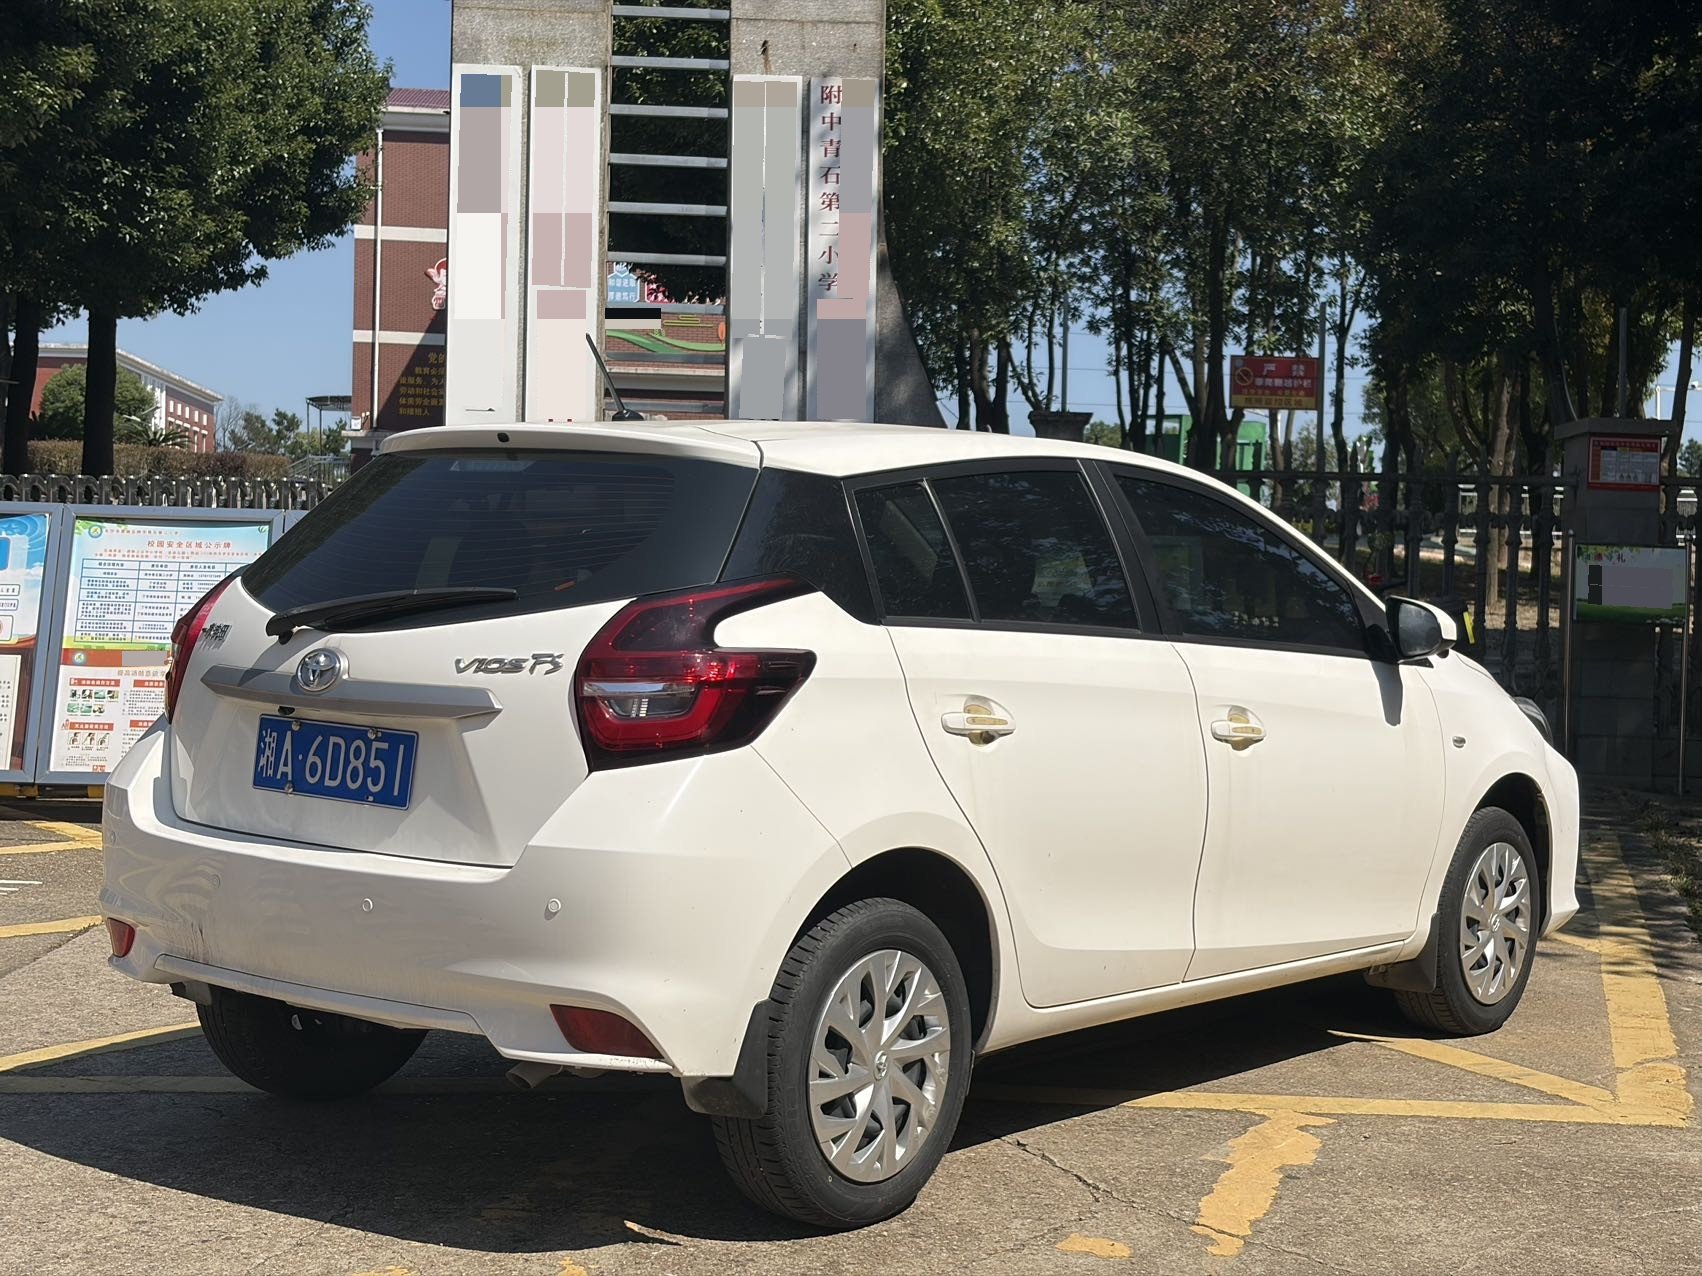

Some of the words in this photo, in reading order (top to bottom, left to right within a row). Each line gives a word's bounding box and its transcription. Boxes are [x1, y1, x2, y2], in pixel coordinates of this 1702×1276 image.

[147, 540, 232, 549] 校园安全区域公示牌
